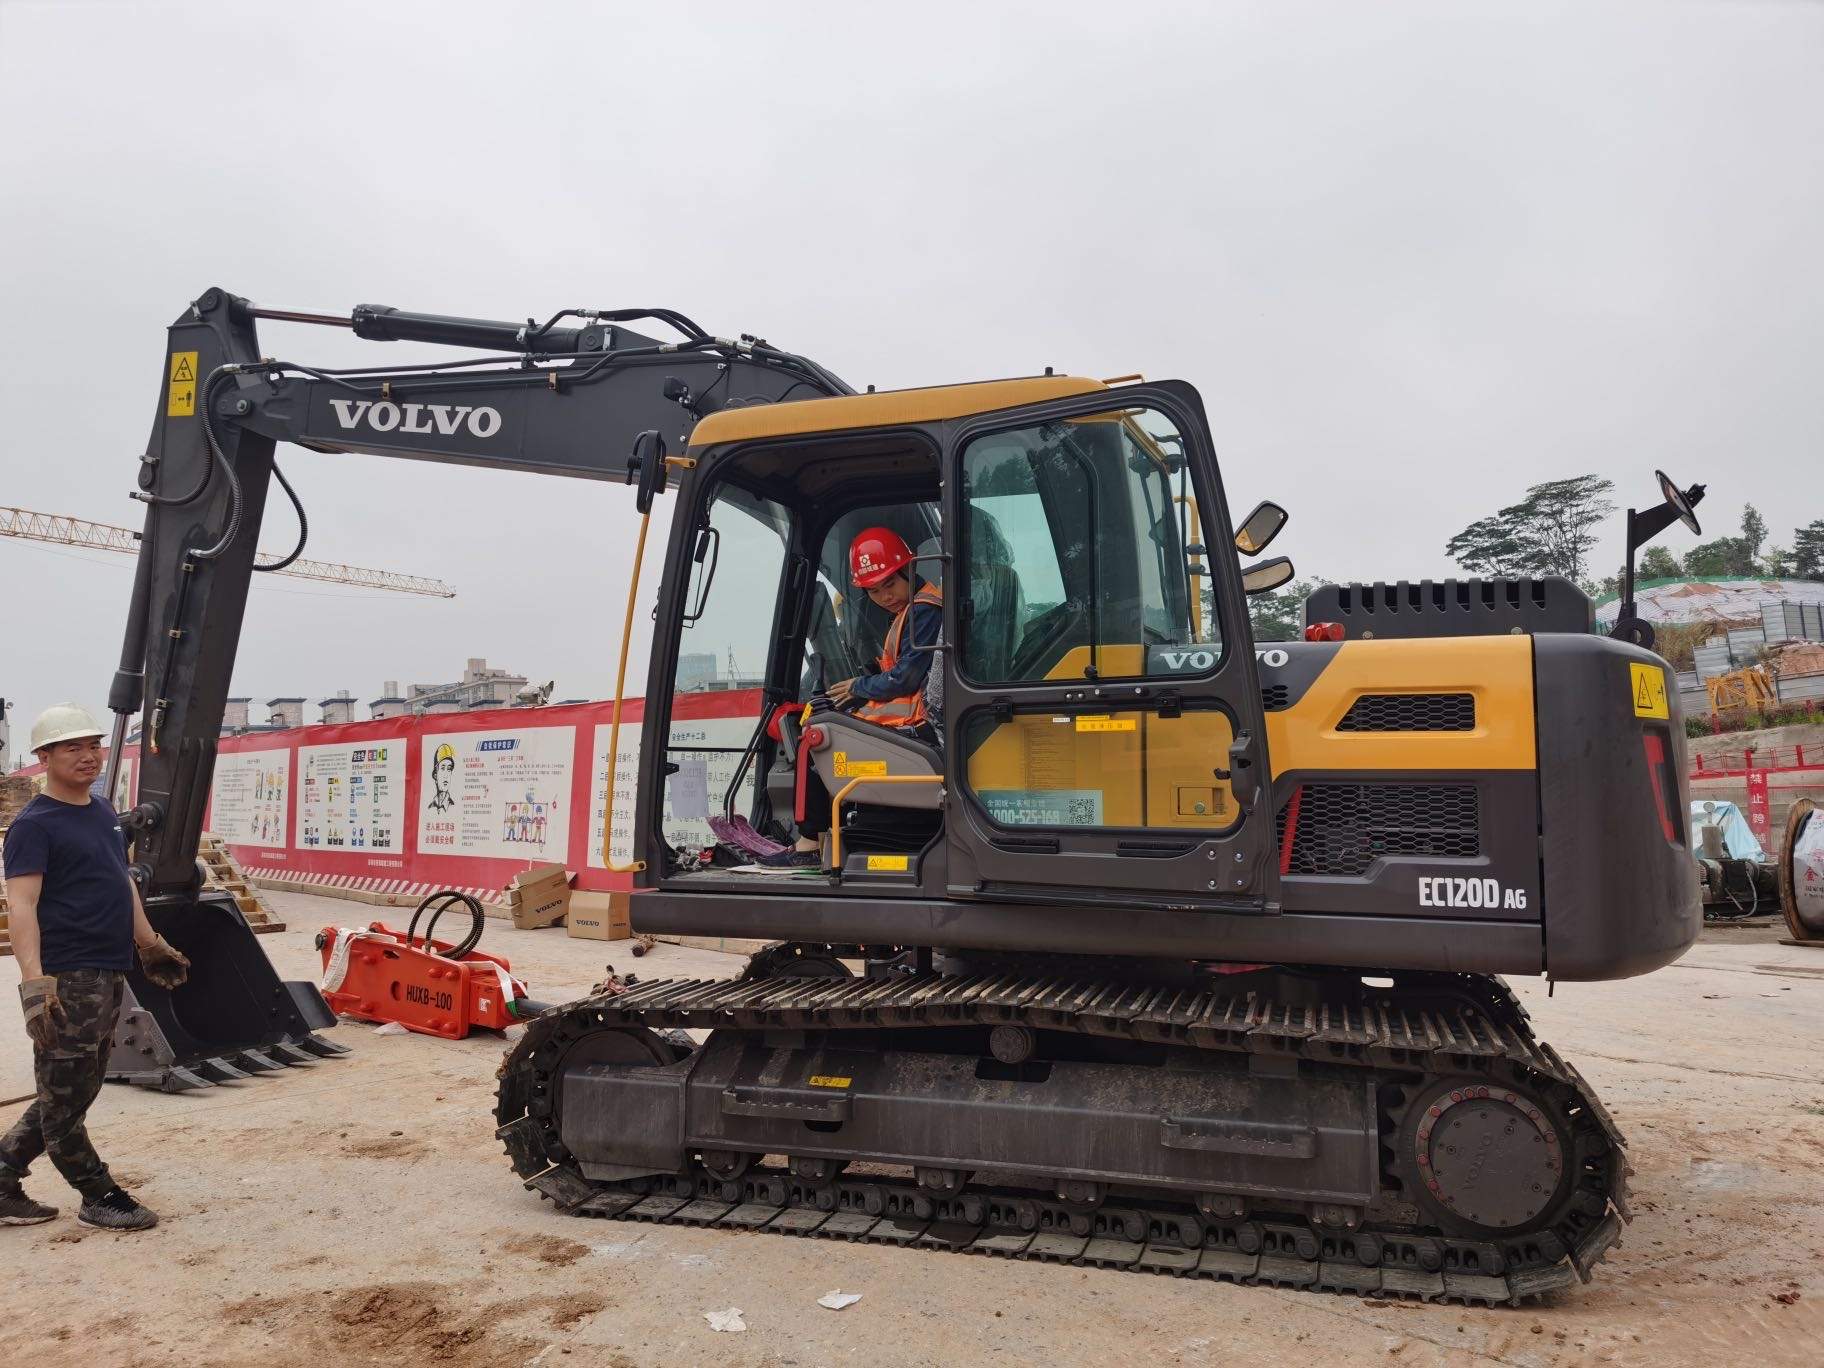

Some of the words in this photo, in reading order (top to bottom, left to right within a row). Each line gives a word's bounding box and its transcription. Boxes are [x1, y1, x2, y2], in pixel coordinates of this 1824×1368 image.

[329, 399, 502, 438] VOLVO
[1160, 649, 1289, 670] VOO
[1418, 877, 1499, 909] EC120D
[1503, 888, 1527, 909] AG
[535, 899, 563, 914] VOLVO
[576, 919, 600, 927] VOLVO
[406, 983, 453, 1011] HUXB-100
